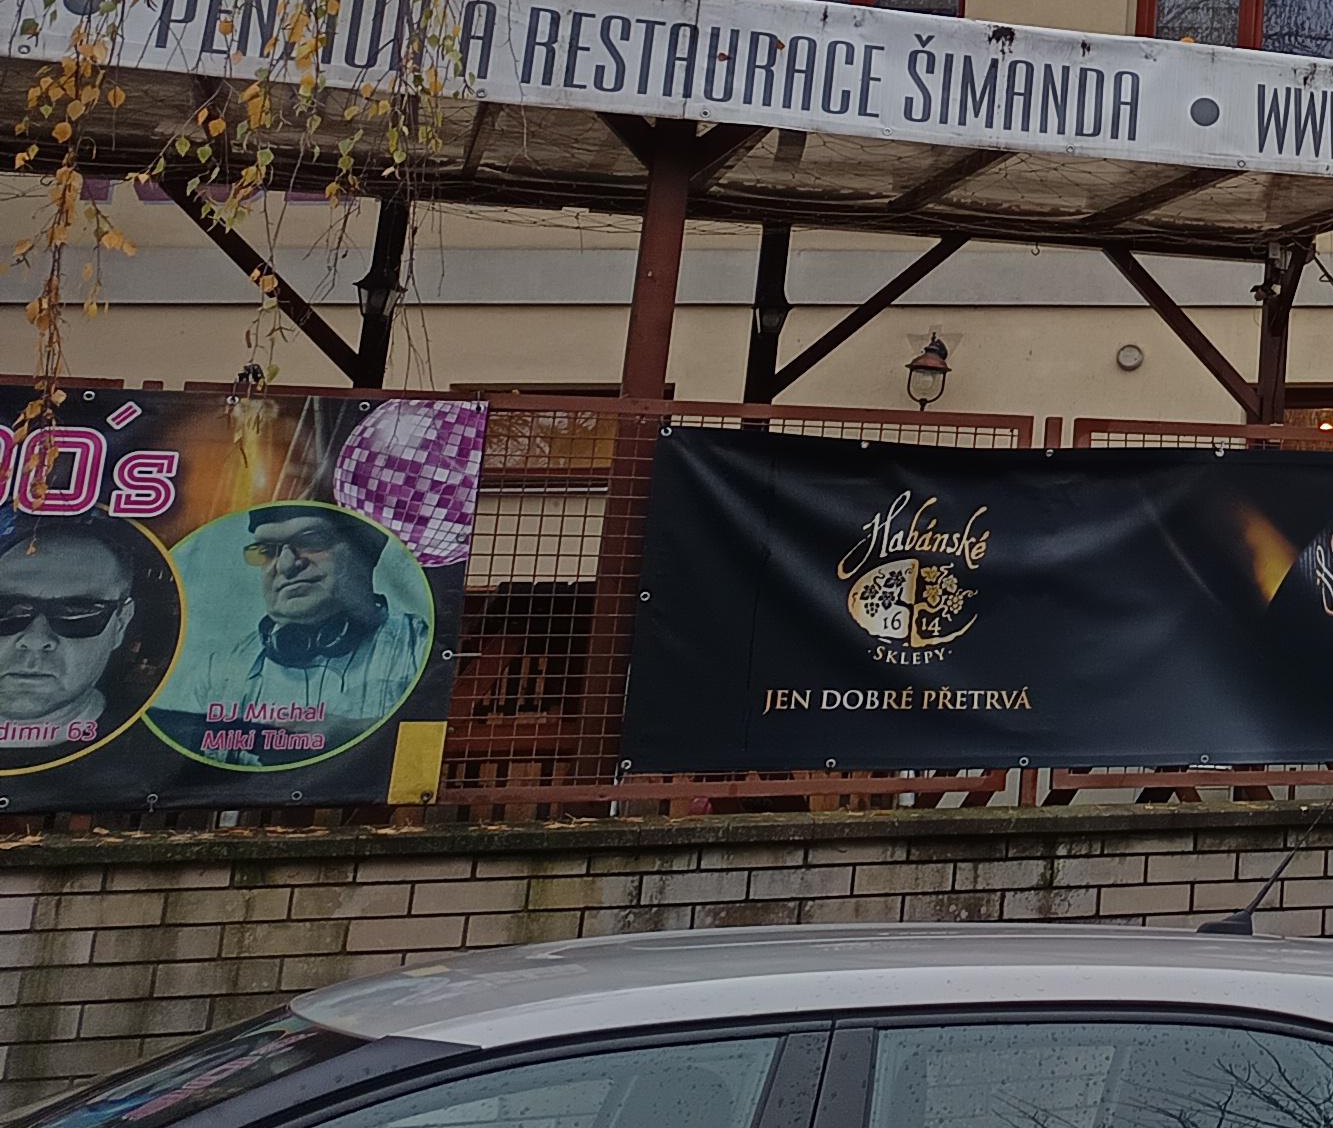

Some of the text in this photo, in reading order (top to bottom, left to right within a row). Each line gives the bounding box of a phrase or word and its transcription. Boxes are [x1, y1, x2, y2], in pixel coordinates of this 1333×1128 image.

[458, 0, 497, 80] A
[520, 6, 886, 118] RESTAURACE
[903, 34, 1141, 142] ŠIMANDA
[837, 490, 990, 580] Habánské
[872, 645, 947, 665] SKLEPY
[762, 685, 1033, 715] JEN DOBRÉ PŘETRVÁ
[207, 702, 326, 722] DJ Michal
[67, 721, 98, 742] 63
[201, 729, 255, 750] Miki
